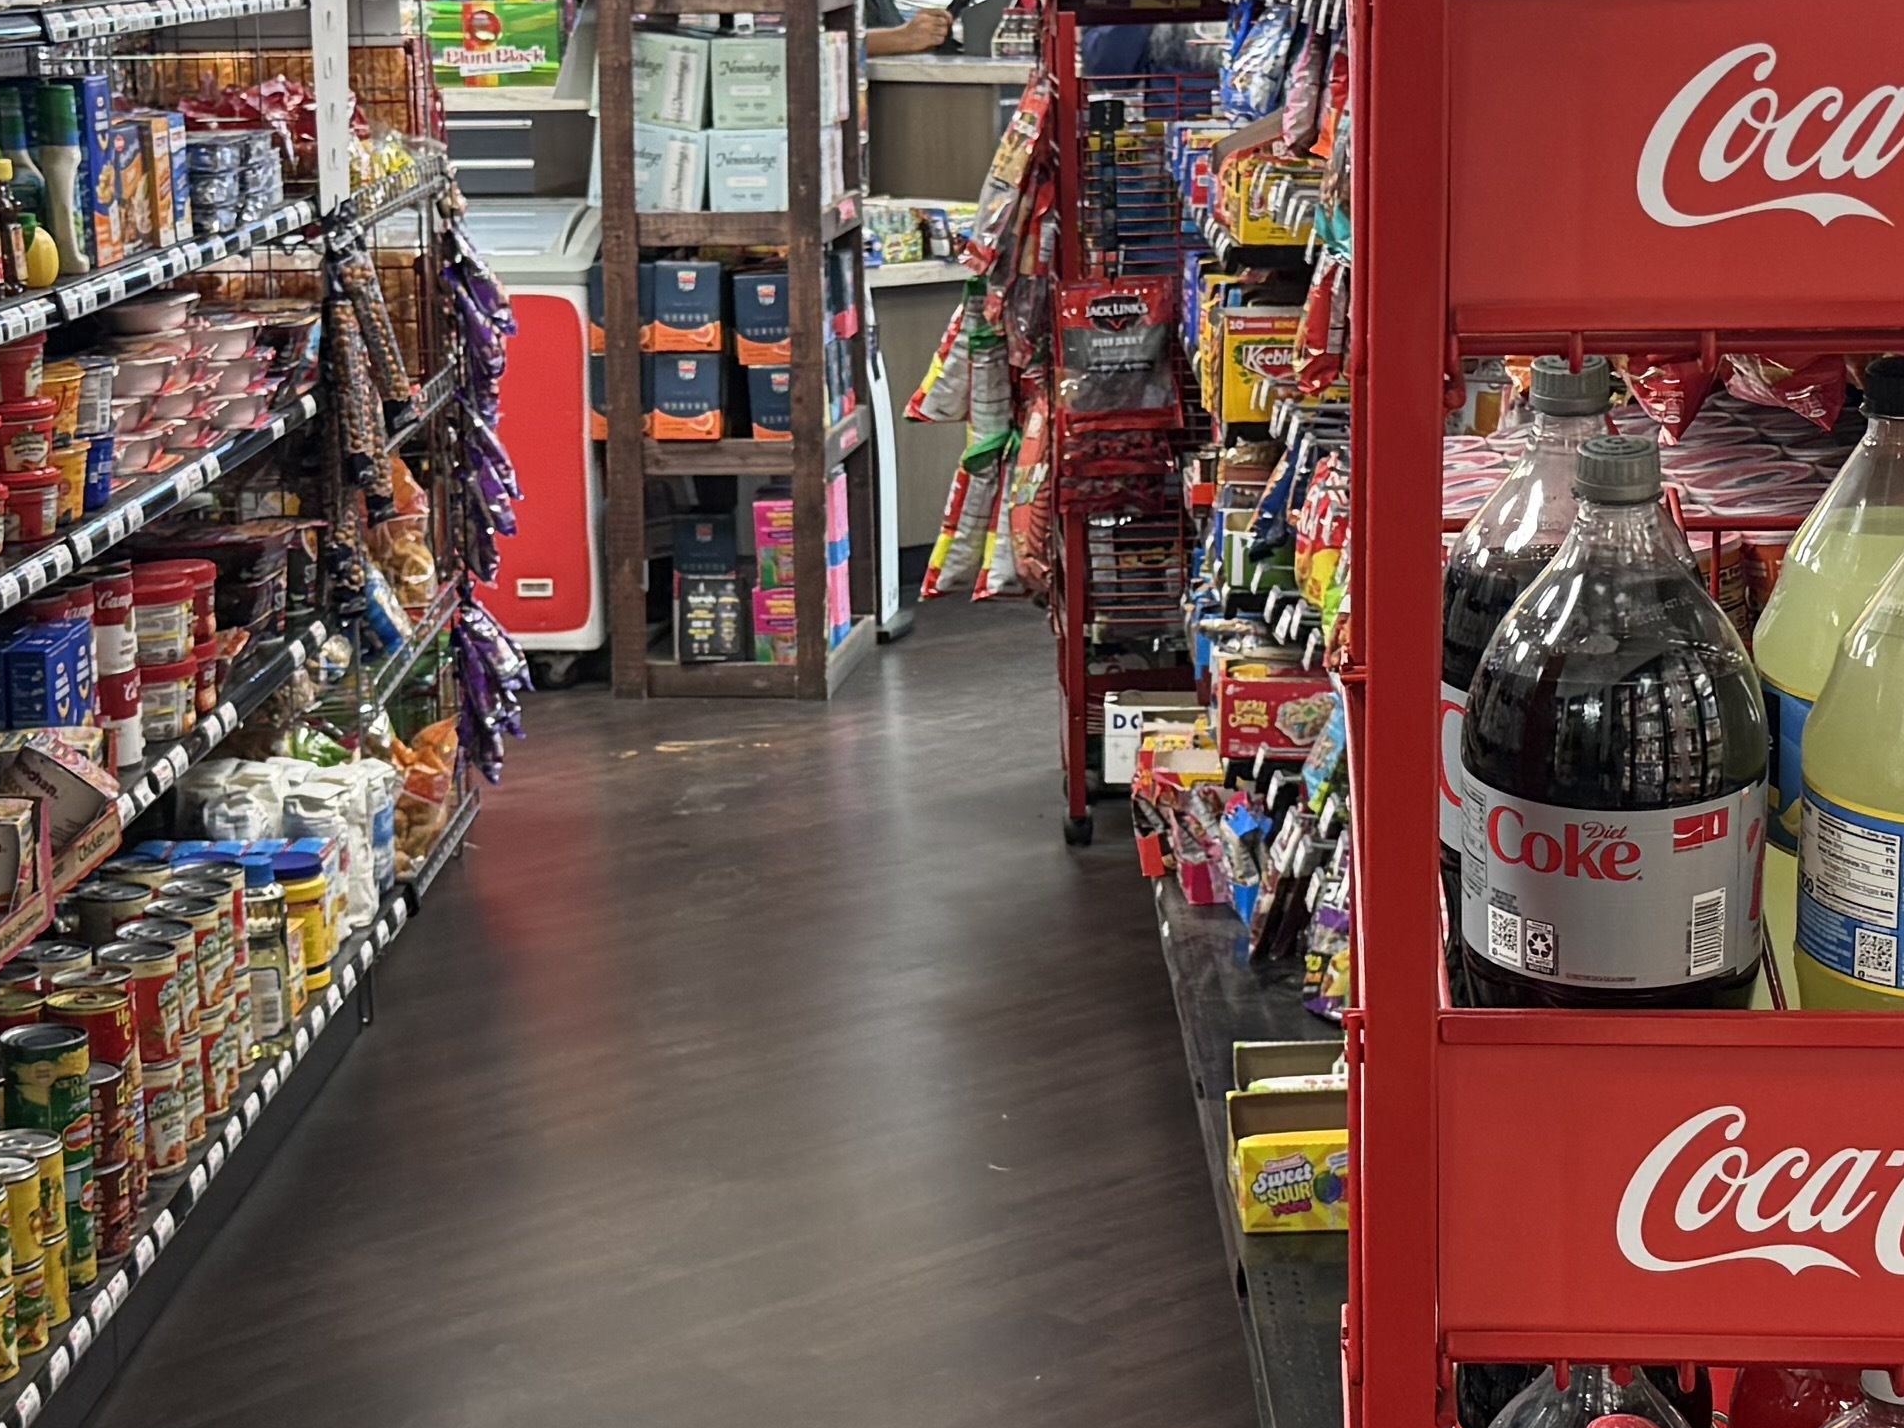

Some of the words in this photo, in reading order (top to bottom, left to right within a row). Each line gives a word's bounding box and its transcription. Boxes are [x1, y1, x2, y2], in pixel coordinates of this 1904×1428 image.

[444, 46, 493, 65] Blunt
[495, 45, 546, 65] Black
[1086, 302, 1117, 320] JACK
[1582, 822, 1628, 840] Diet
[1488, 805, 1642, 882] Coke
[1253, 1161, 1315, 1194] Sweet
[1266, 1184, 1312, 1207] SOUR
